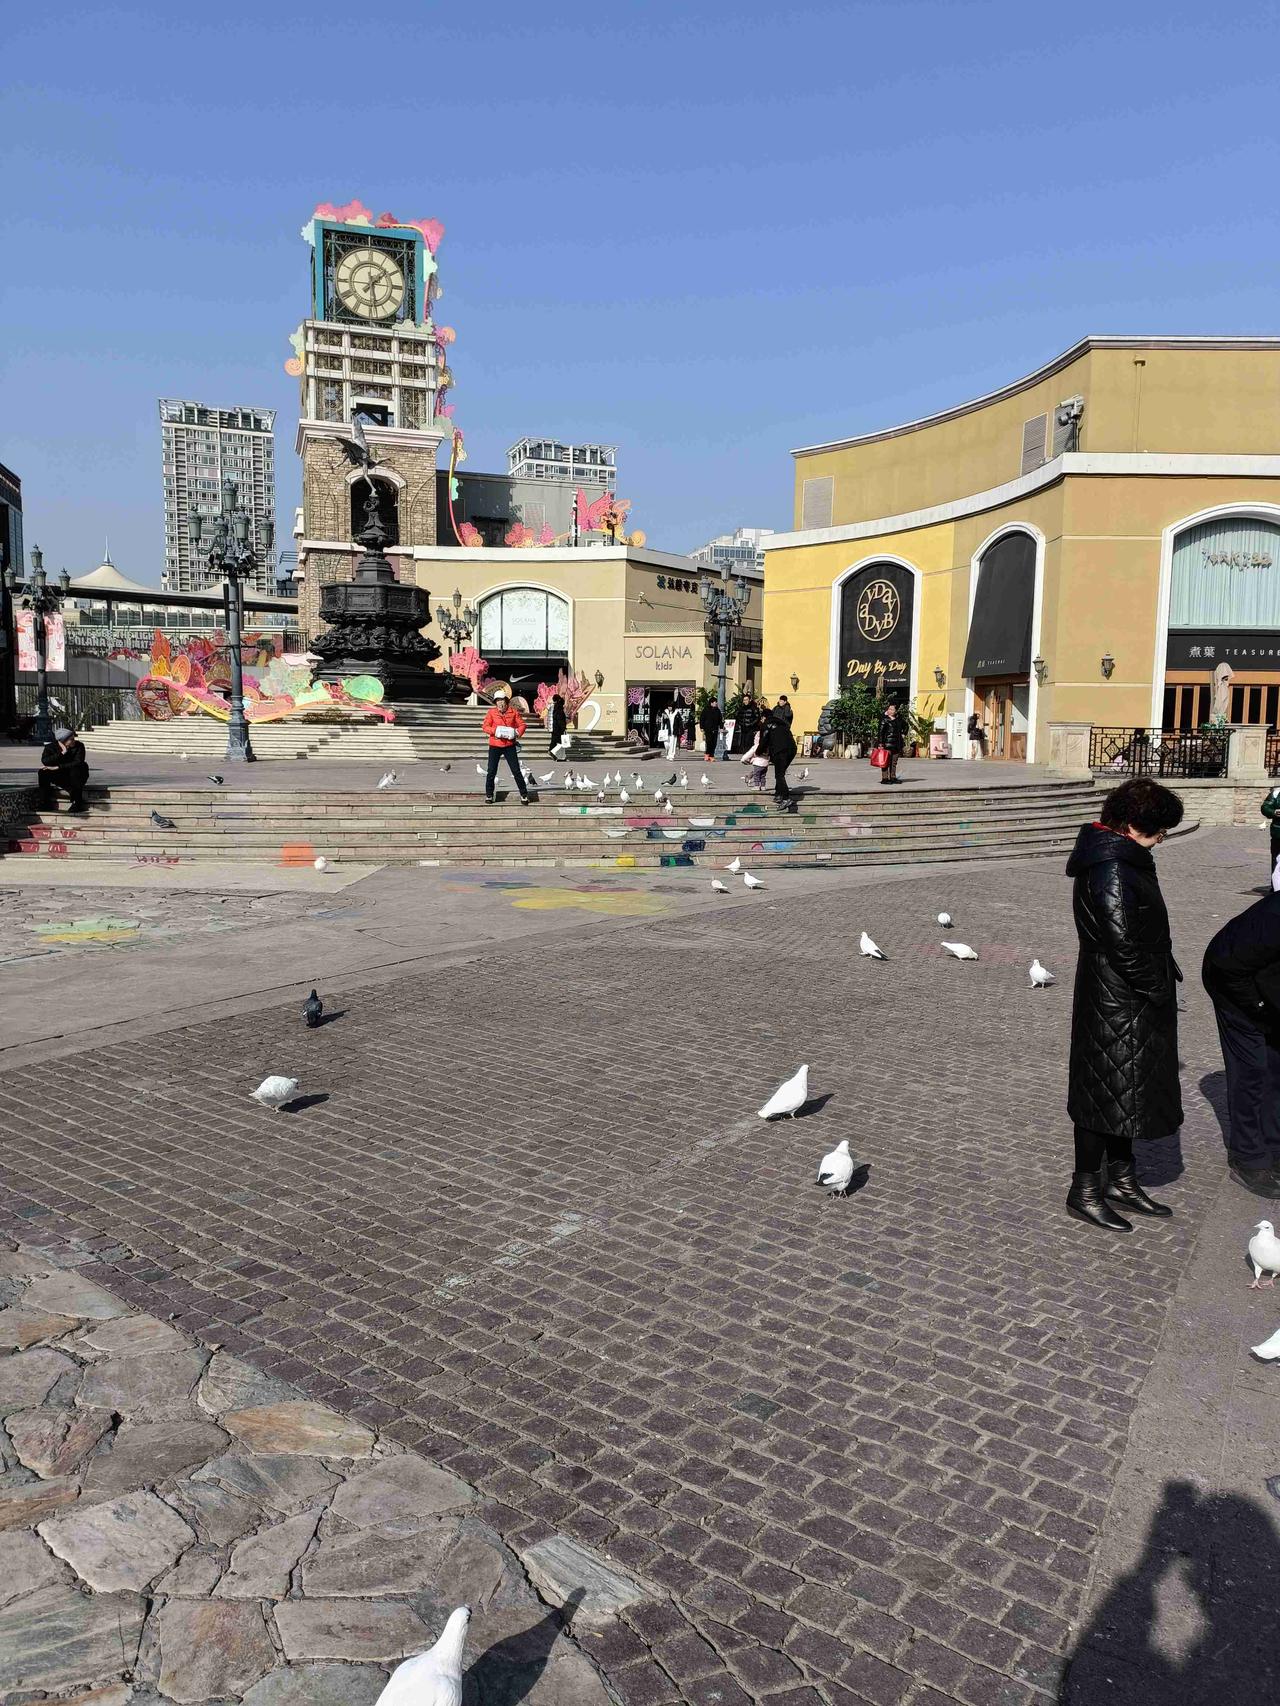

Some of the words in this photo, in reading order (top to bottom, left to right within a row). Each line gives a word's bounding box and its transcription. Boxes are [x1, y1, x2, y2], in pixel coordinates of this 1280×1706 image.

[635, 645, 693, 659] SOLANA
[1225, 648, 1280, 656] TEASURE
[655, 661, 673, 671] kids
[847, 658, 872, 679] Day
[874, 659, 887, 676] By
[888, 660, 907, 675] Day
